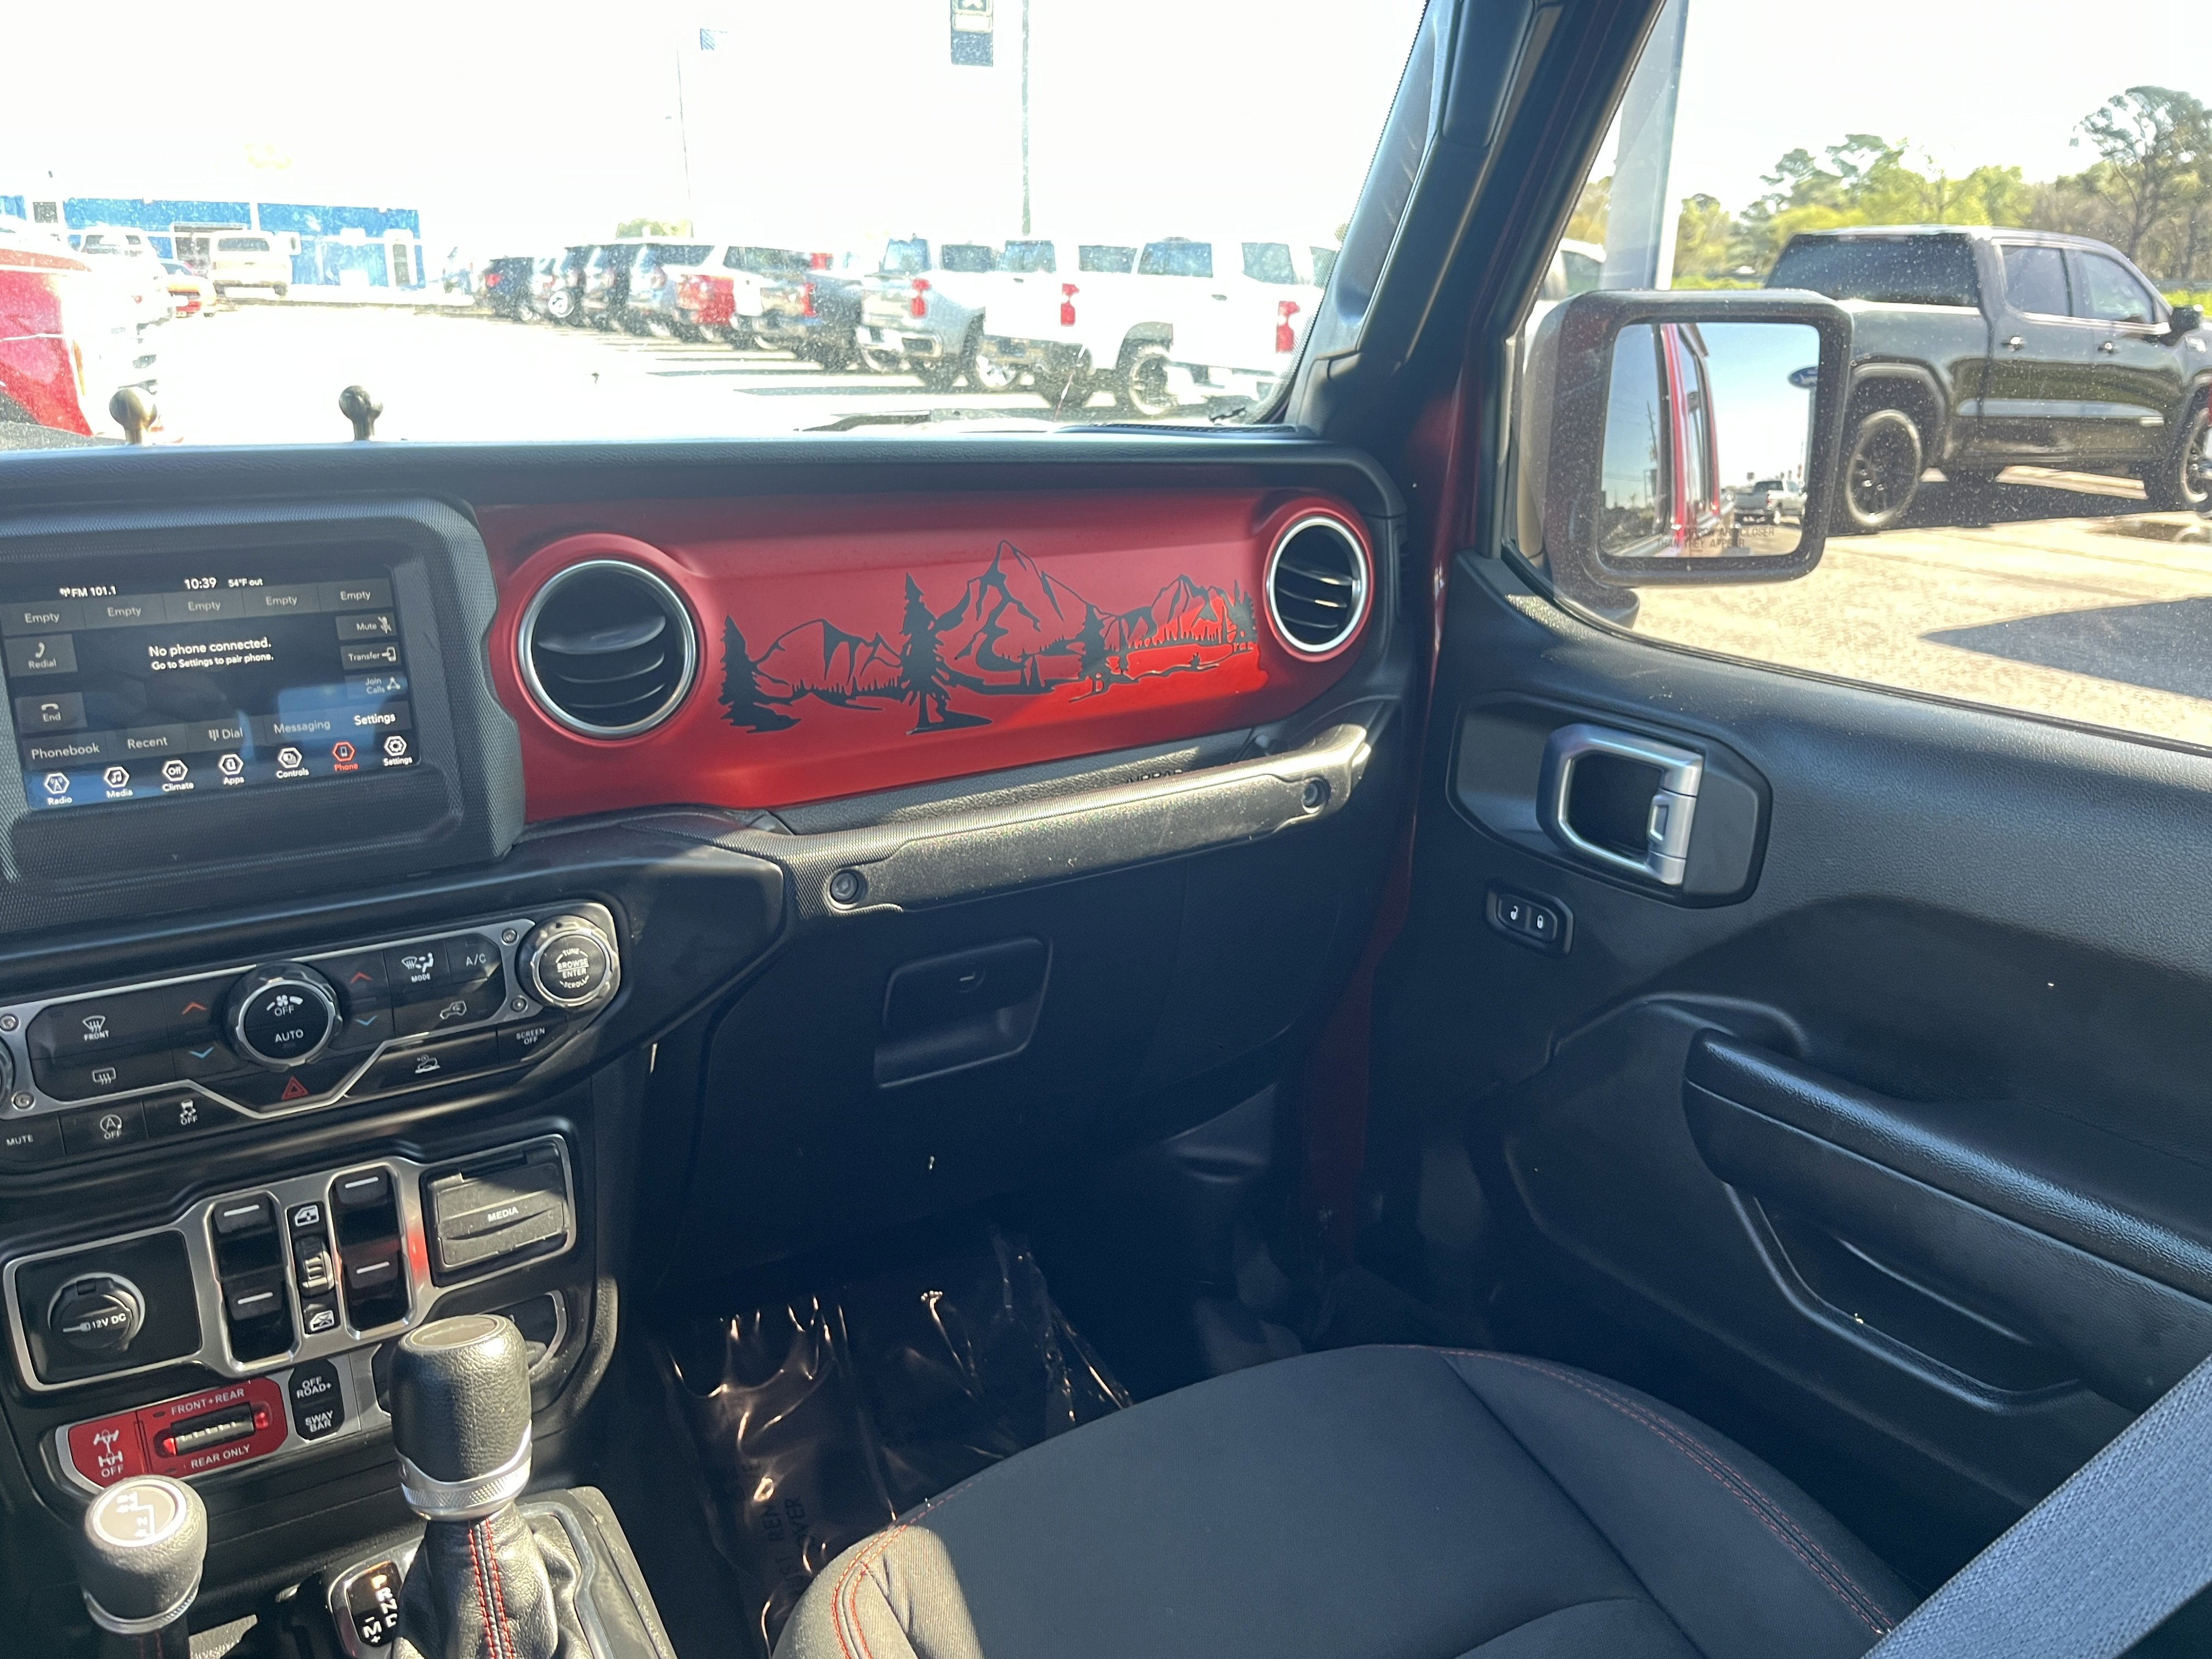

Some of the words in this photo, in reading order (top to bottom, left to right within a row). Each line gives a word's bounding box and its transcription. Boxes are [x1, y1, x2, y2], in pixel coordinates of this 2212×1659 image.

[1740, 527, 1774, 537] CLOSER
[184, 577, 217, 590] 10:39
[249, 578, 264, 587] out
[71, 588, 88, 598] FM
[90, 585, 117, 597] 101.1
[340, 590, 371, 601] Empty
[266, 595, 297, 606] Empty
[188, 601, 221, 612] Empty
[107, 607, 142, 618] Empty
[25, 613, 60, 624] Empty
[357, 622, 377, 631] Mute
[149, 646, 167, 657] No
[170, 644, 207, 658] phone
[210, 636, 272, 652] connected.
[151, 661, 166, 670] Go
[167, 661, 178, 669] to
[178, 658, 213, 668] Settings
[215, 657, 224, 665] to
[226, 654, 242, 665] pair
[244, 653, 274, 664] phone.
[348, 651, 381, 662] Transfer
[29, 658, 57, 669] Redial
[365, 677, 382, 686] Join
[366, 685, 385, 695] Calls
[42, 712, 61, 723] End
[353, 712, 397, 726] Settings
[274, 719, 331, 735] Messaging
[222, 727, 243, 740] Dial
[127, 736, 168, 750] Recent
[31, 742, 100, 760] Phonebook
[334, 763, 358, 772] Phone
[383, 757, 413, 767] Settings
[276, 768, 309, 779] Controls
[223, 776, 245, 786] Apps
[161, 782, 194, 792] Climate
[106, 788, 133, 798] Media
[47, 796, 73, 805] Radio
[562, 948, 580, 956] TUNE
[466, 953, 487, 967] A/C
[557, 958, 589, 970] BROWSE
[411, 973, 431, 983] MODE
[562, 967, 587, 979] ENTER
[563, 979, 587, 989] SCROLL
[275, 1005, 295, 1017] OFF
[84, 1030, 110, 1041] FRONT
[275, 1029, 304, 1042] AUTO
[516, 1027, 545, 1040] SCREEN
[524, 1036, 538, 1045] OFF
[181, 1114, 198, 1125] OFF
[104, 1130, 122, 1139] OFF
[6, 1134, 34, 1147] MUTE
[488, 1206, 519, 1222] MEDIA
[92, 1317, 109, 1329] 12V
[111, 1313, 127, 1324] DC
[302, 1376, 322, 1389] OFF
[305, 1409, 333, 1426] SWAY
[310, 1419, 331, 1432] BAR
[191, 1452, 220, 1469] REAR
[223, 1444, 250, 1460] ONLY
[101, 1464, 123, 1477] OFF
[371, 1574, 387, 1589] P
[377, 1587, 393, 1602] R
[381, 1598, 398, 1614] N
[363, 1621, 382, 1638] M
